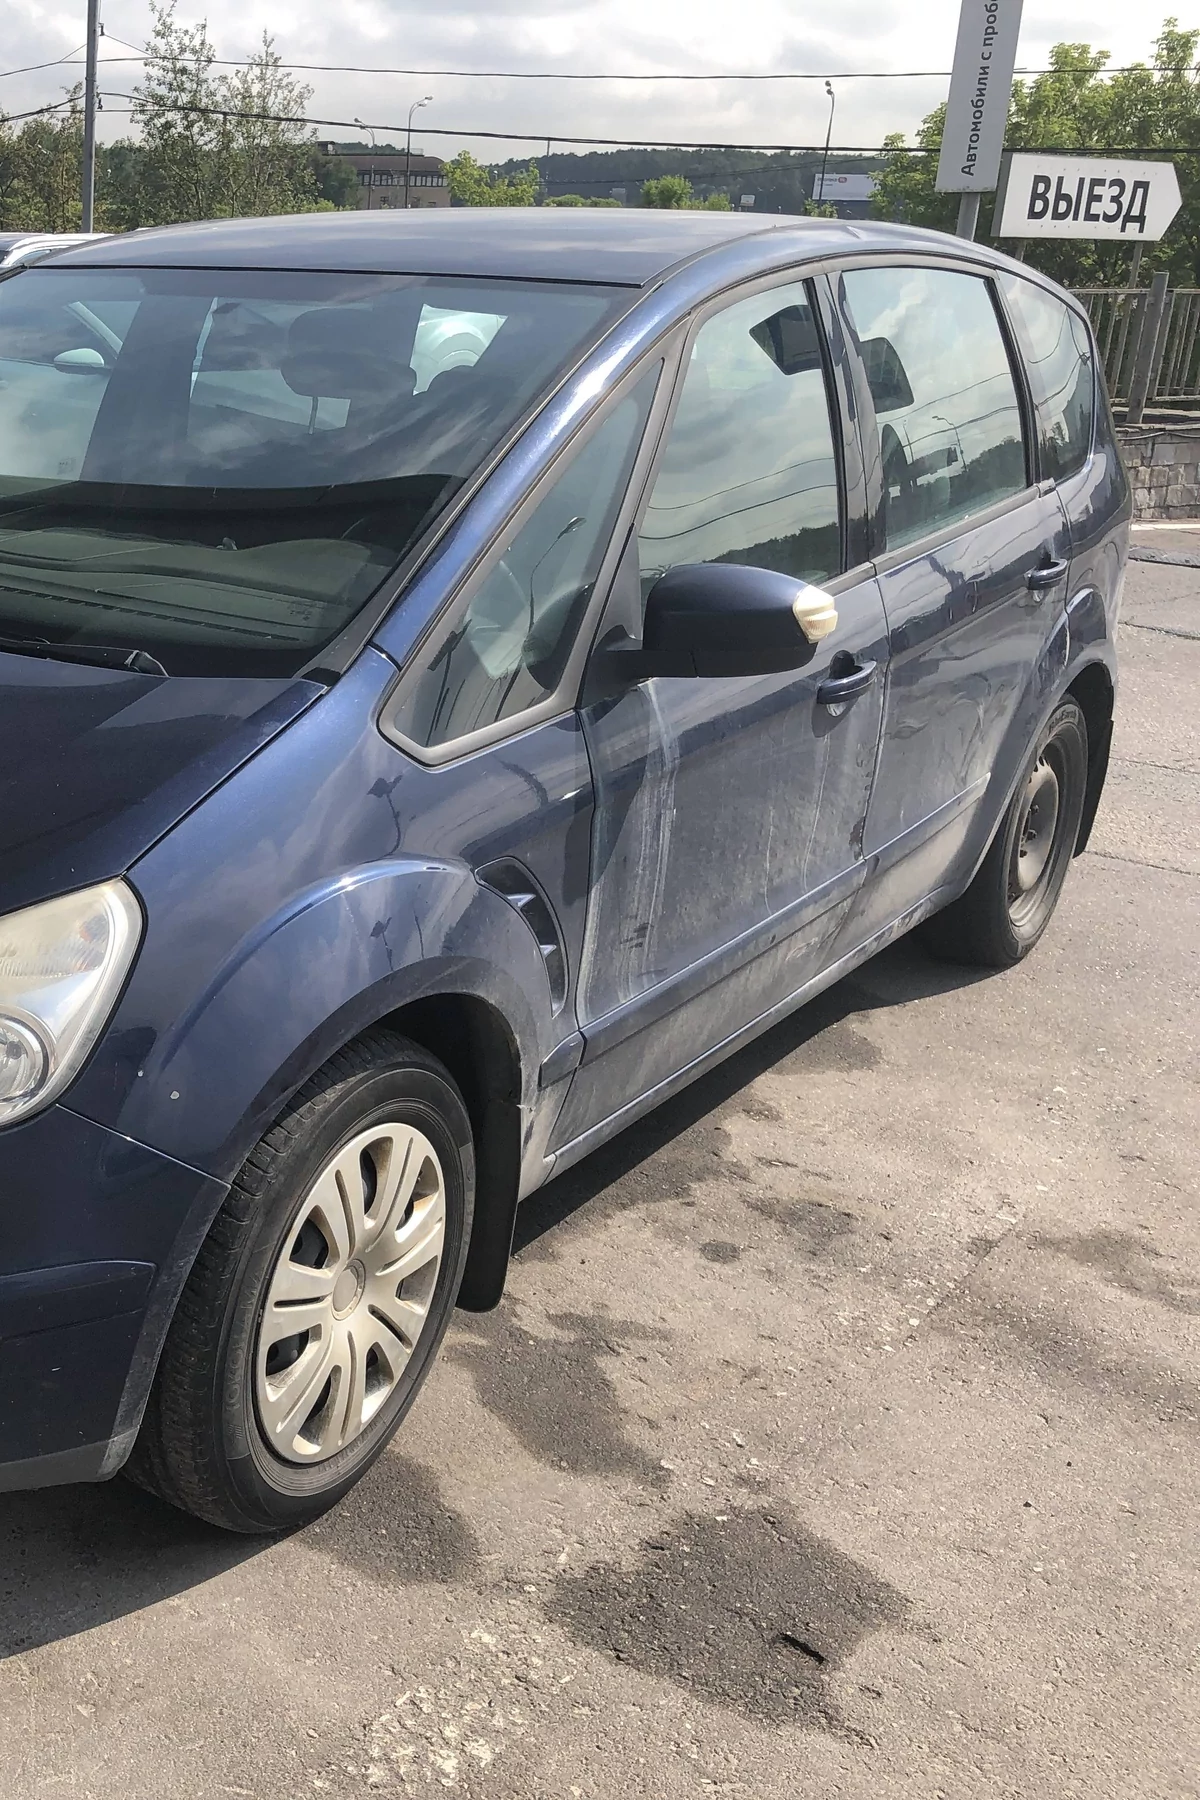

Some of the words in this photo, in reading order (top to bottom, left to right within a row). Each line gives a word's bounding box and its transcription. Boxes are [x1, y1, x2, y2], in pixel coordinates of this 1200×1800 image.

[983, 0, 999, 47] проб
[981, 51, 992, 61] с
[960, 65, 991, 177] Автомобили
[1027, 174, 1151, 234] ВЫЕЗД
